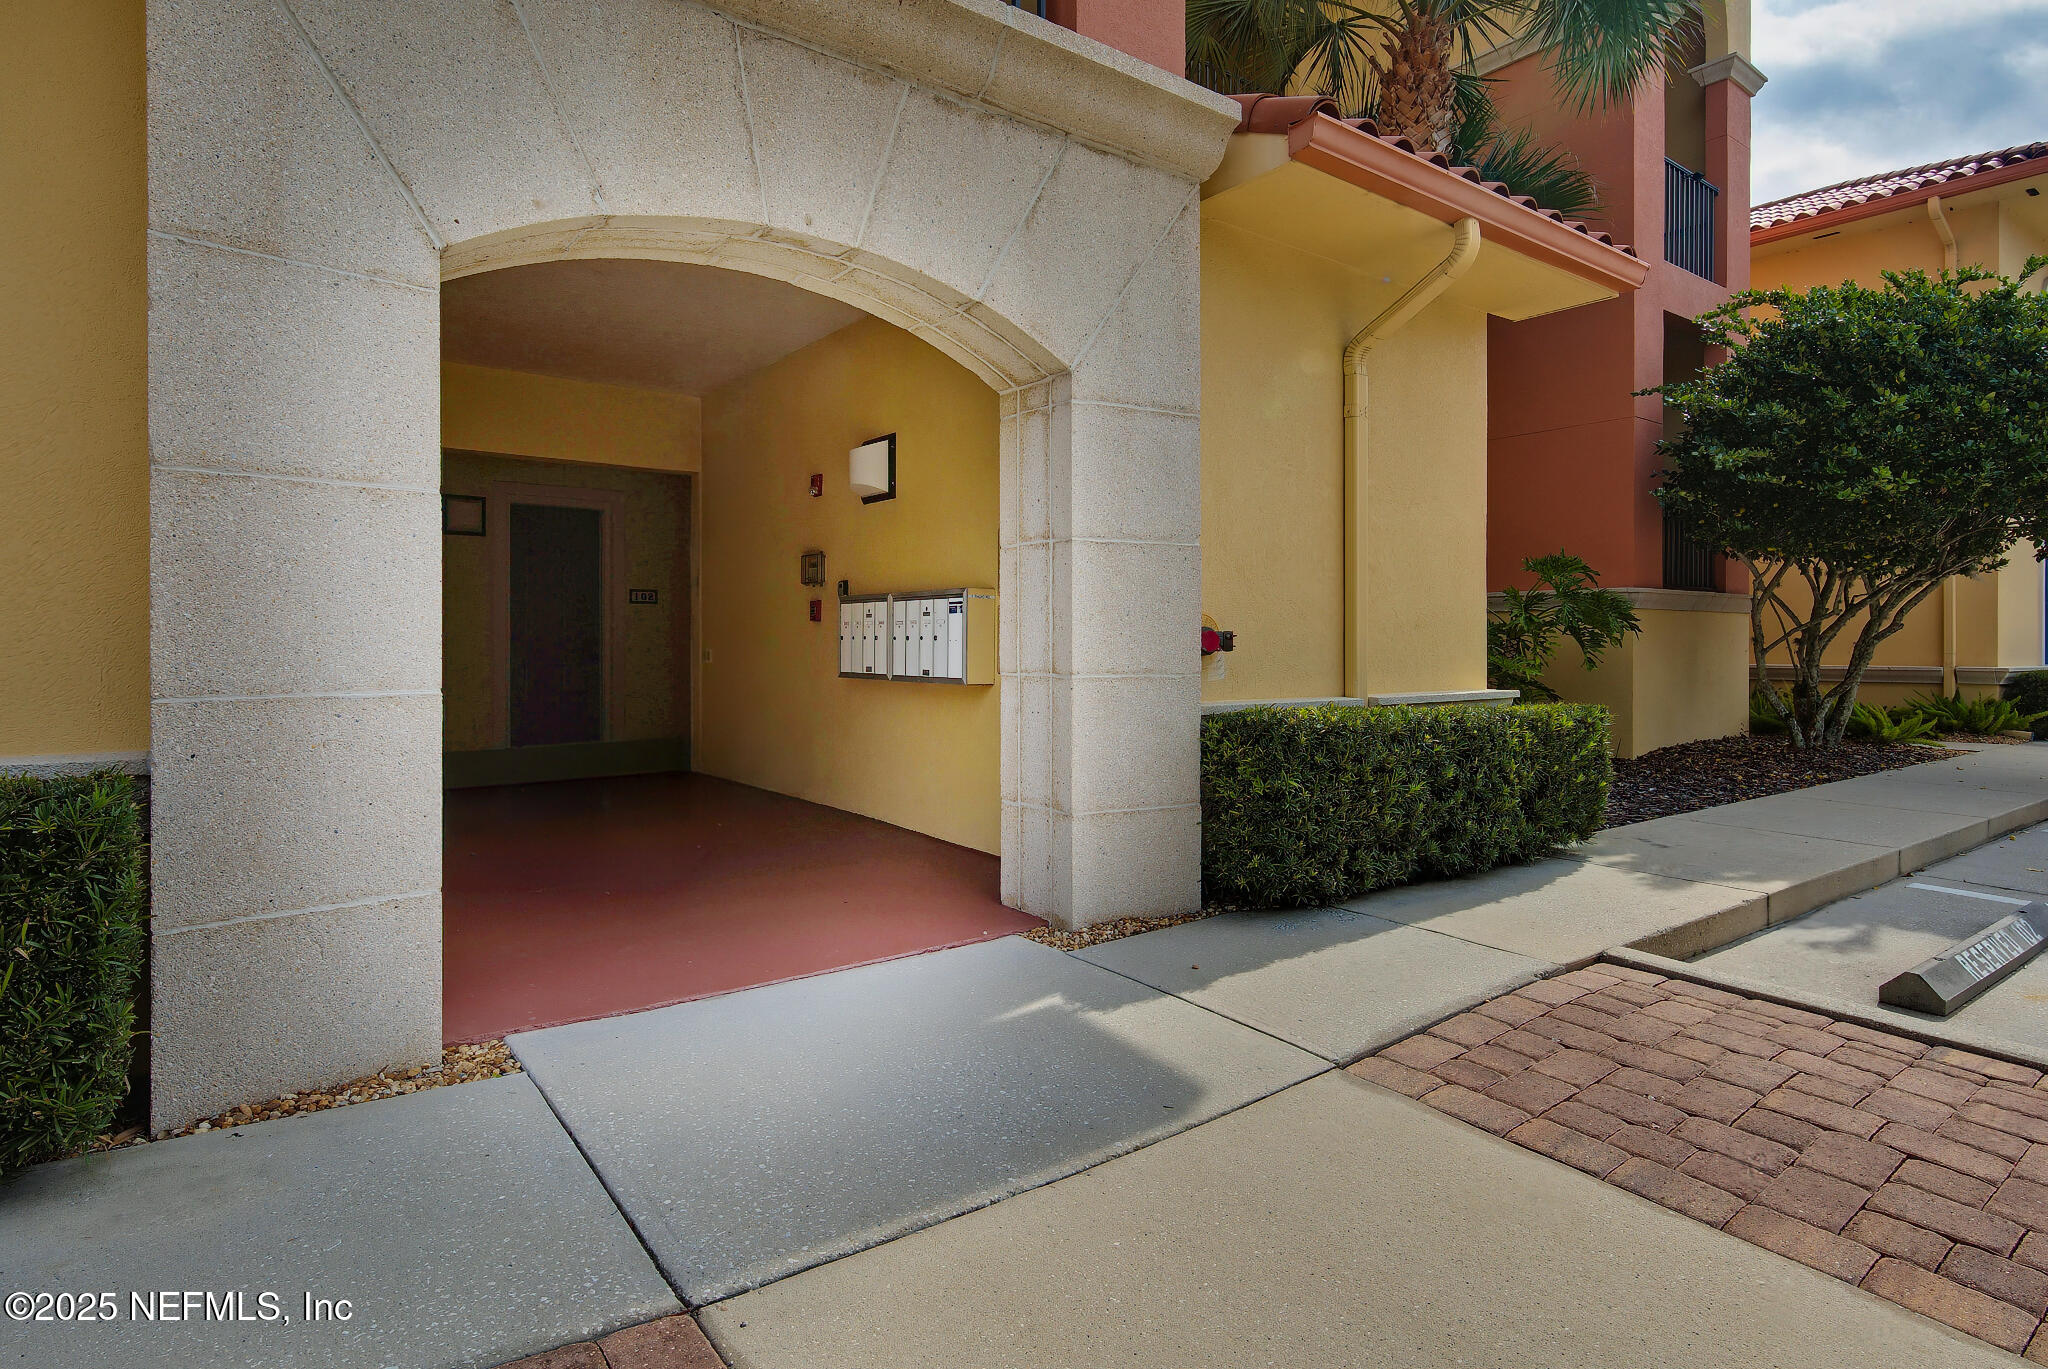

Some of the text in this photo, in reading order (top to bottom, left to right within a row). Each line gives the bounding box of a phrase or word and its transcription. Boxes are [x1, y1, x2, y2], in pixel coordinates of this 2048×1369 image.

[634, 592, 655, 601] 102
[1954, 917, 2043, 981] RESERVED 102
